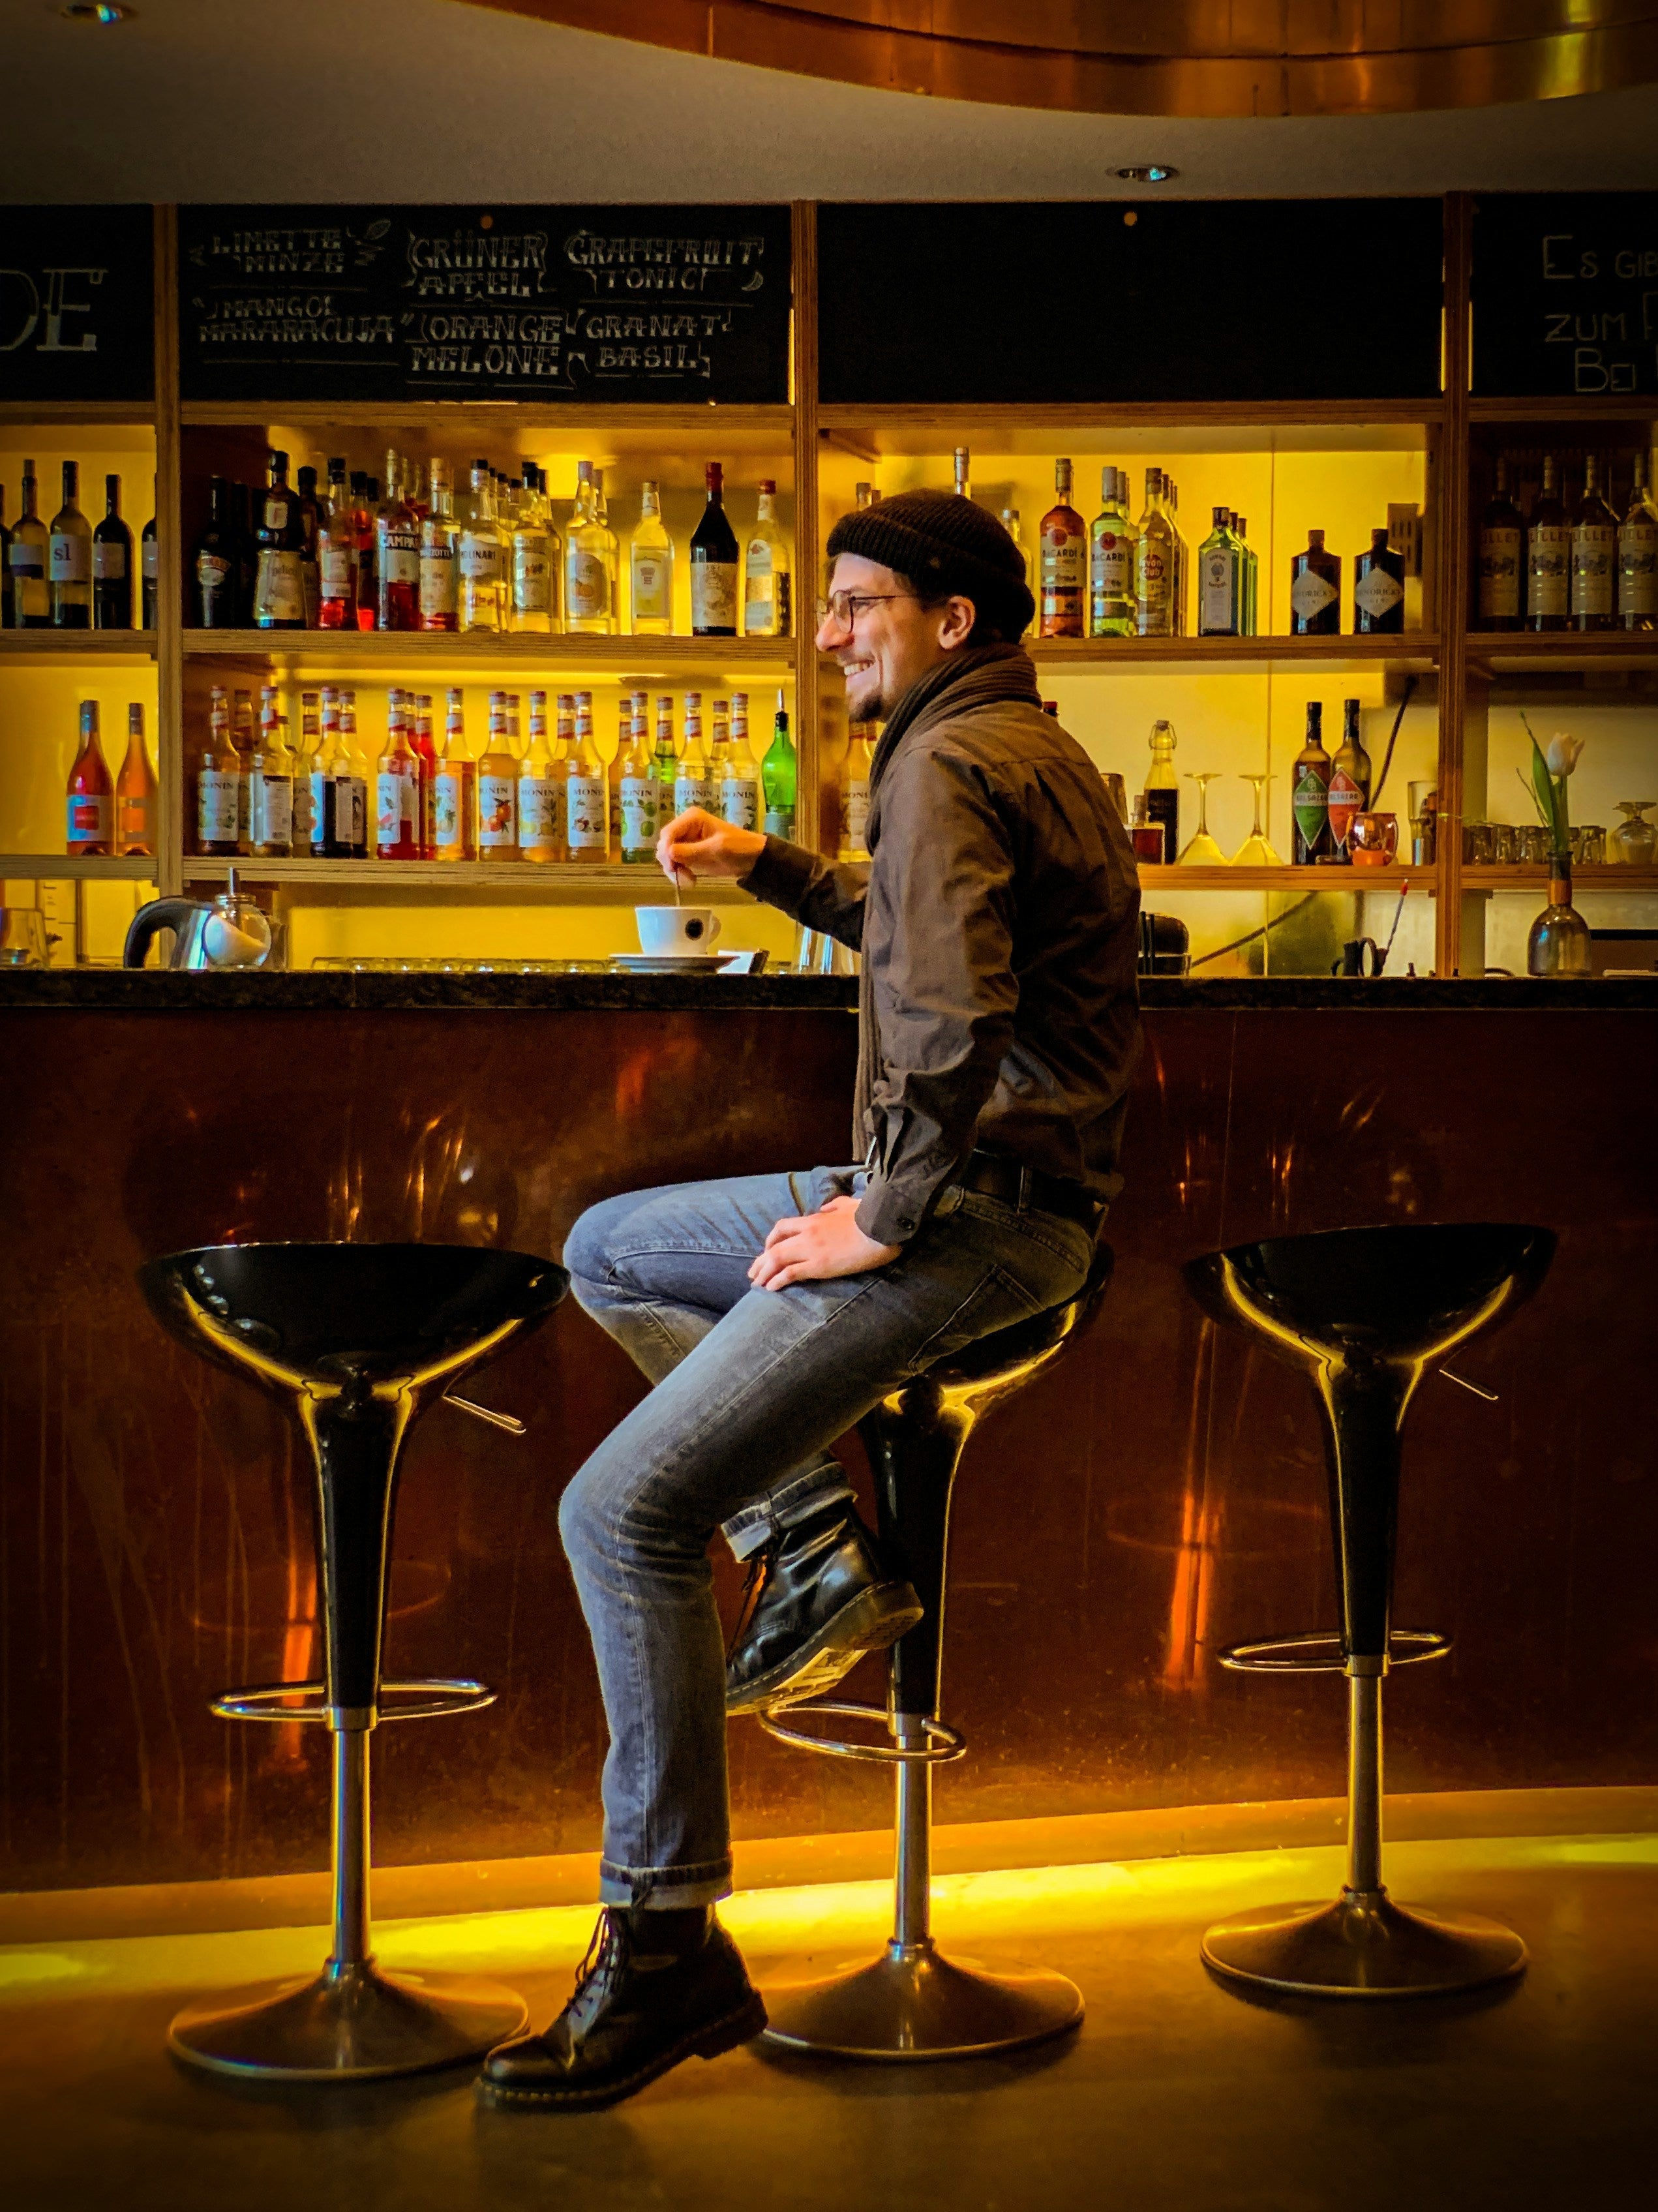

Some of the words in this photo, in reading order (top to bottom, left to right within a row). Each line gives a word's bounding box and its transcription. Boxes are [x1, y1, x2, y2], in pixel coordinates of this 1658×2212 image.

[211, 226, 342, 254] LIMETTE
[412, 230, 541, 268] GRÜNER
[565, 235, 758, 265] GRAPEFRUIT
[244, 251, 345, 273] MINZE
[418, 271, 532, 298] APFEL
[600, 266, 699, 290] TONIC
[429, 314, 564, 344] ORANGE
[586, 314, 721, 339] GRANAT
[411, 344, 561, 375] MELONE
[597, 345, 697, 369] BASIL
[1529, 531, 1571, 542] LLLE
[53, 543, 72, 562] sl
